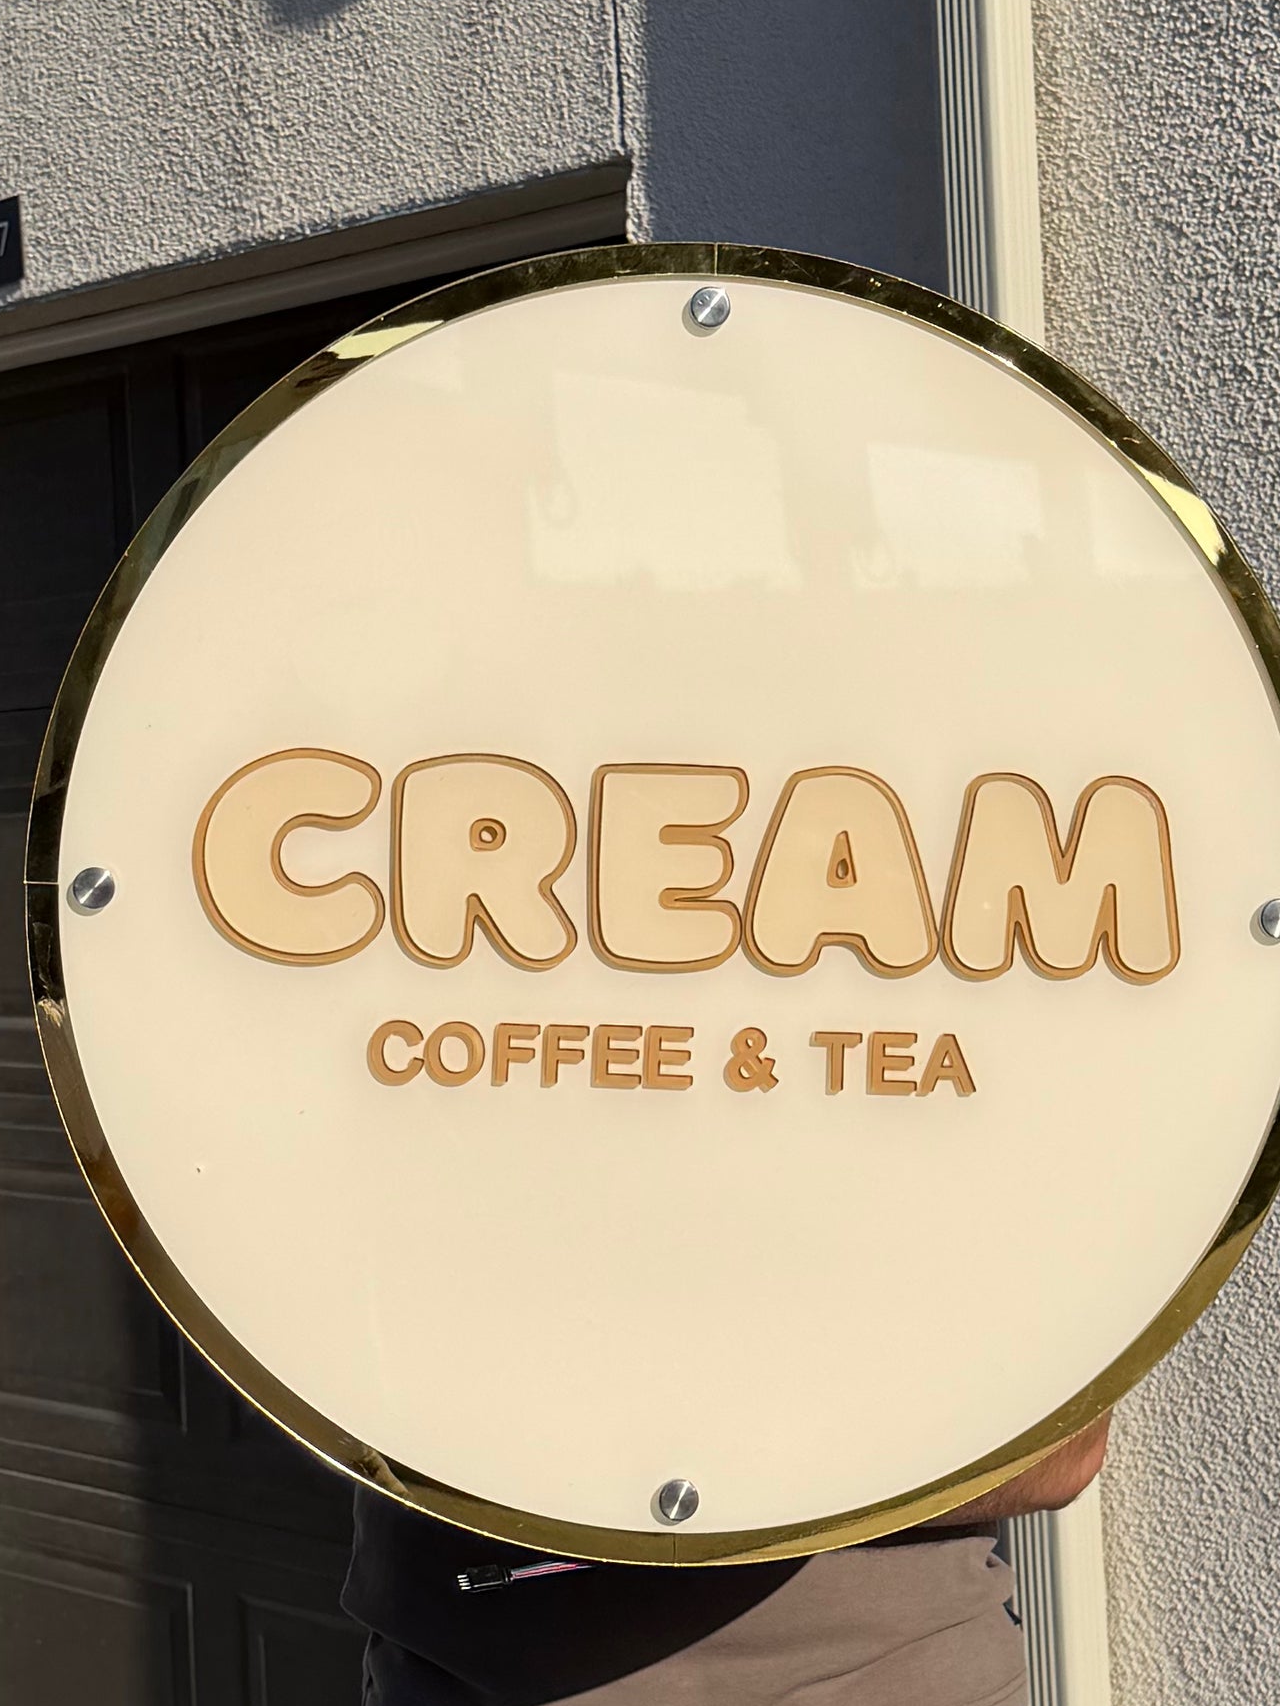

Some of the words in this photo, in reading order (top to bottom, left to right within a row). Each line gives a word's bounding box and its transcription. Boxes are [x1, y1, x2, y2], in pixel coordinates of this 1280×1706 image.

[192, 747, 1181, 984] CREAM
[366, 1019, 696, 1090] COFFEE
[723, 1026, 780, 1094] &
[809, 1031, 978, 1098] TEA
